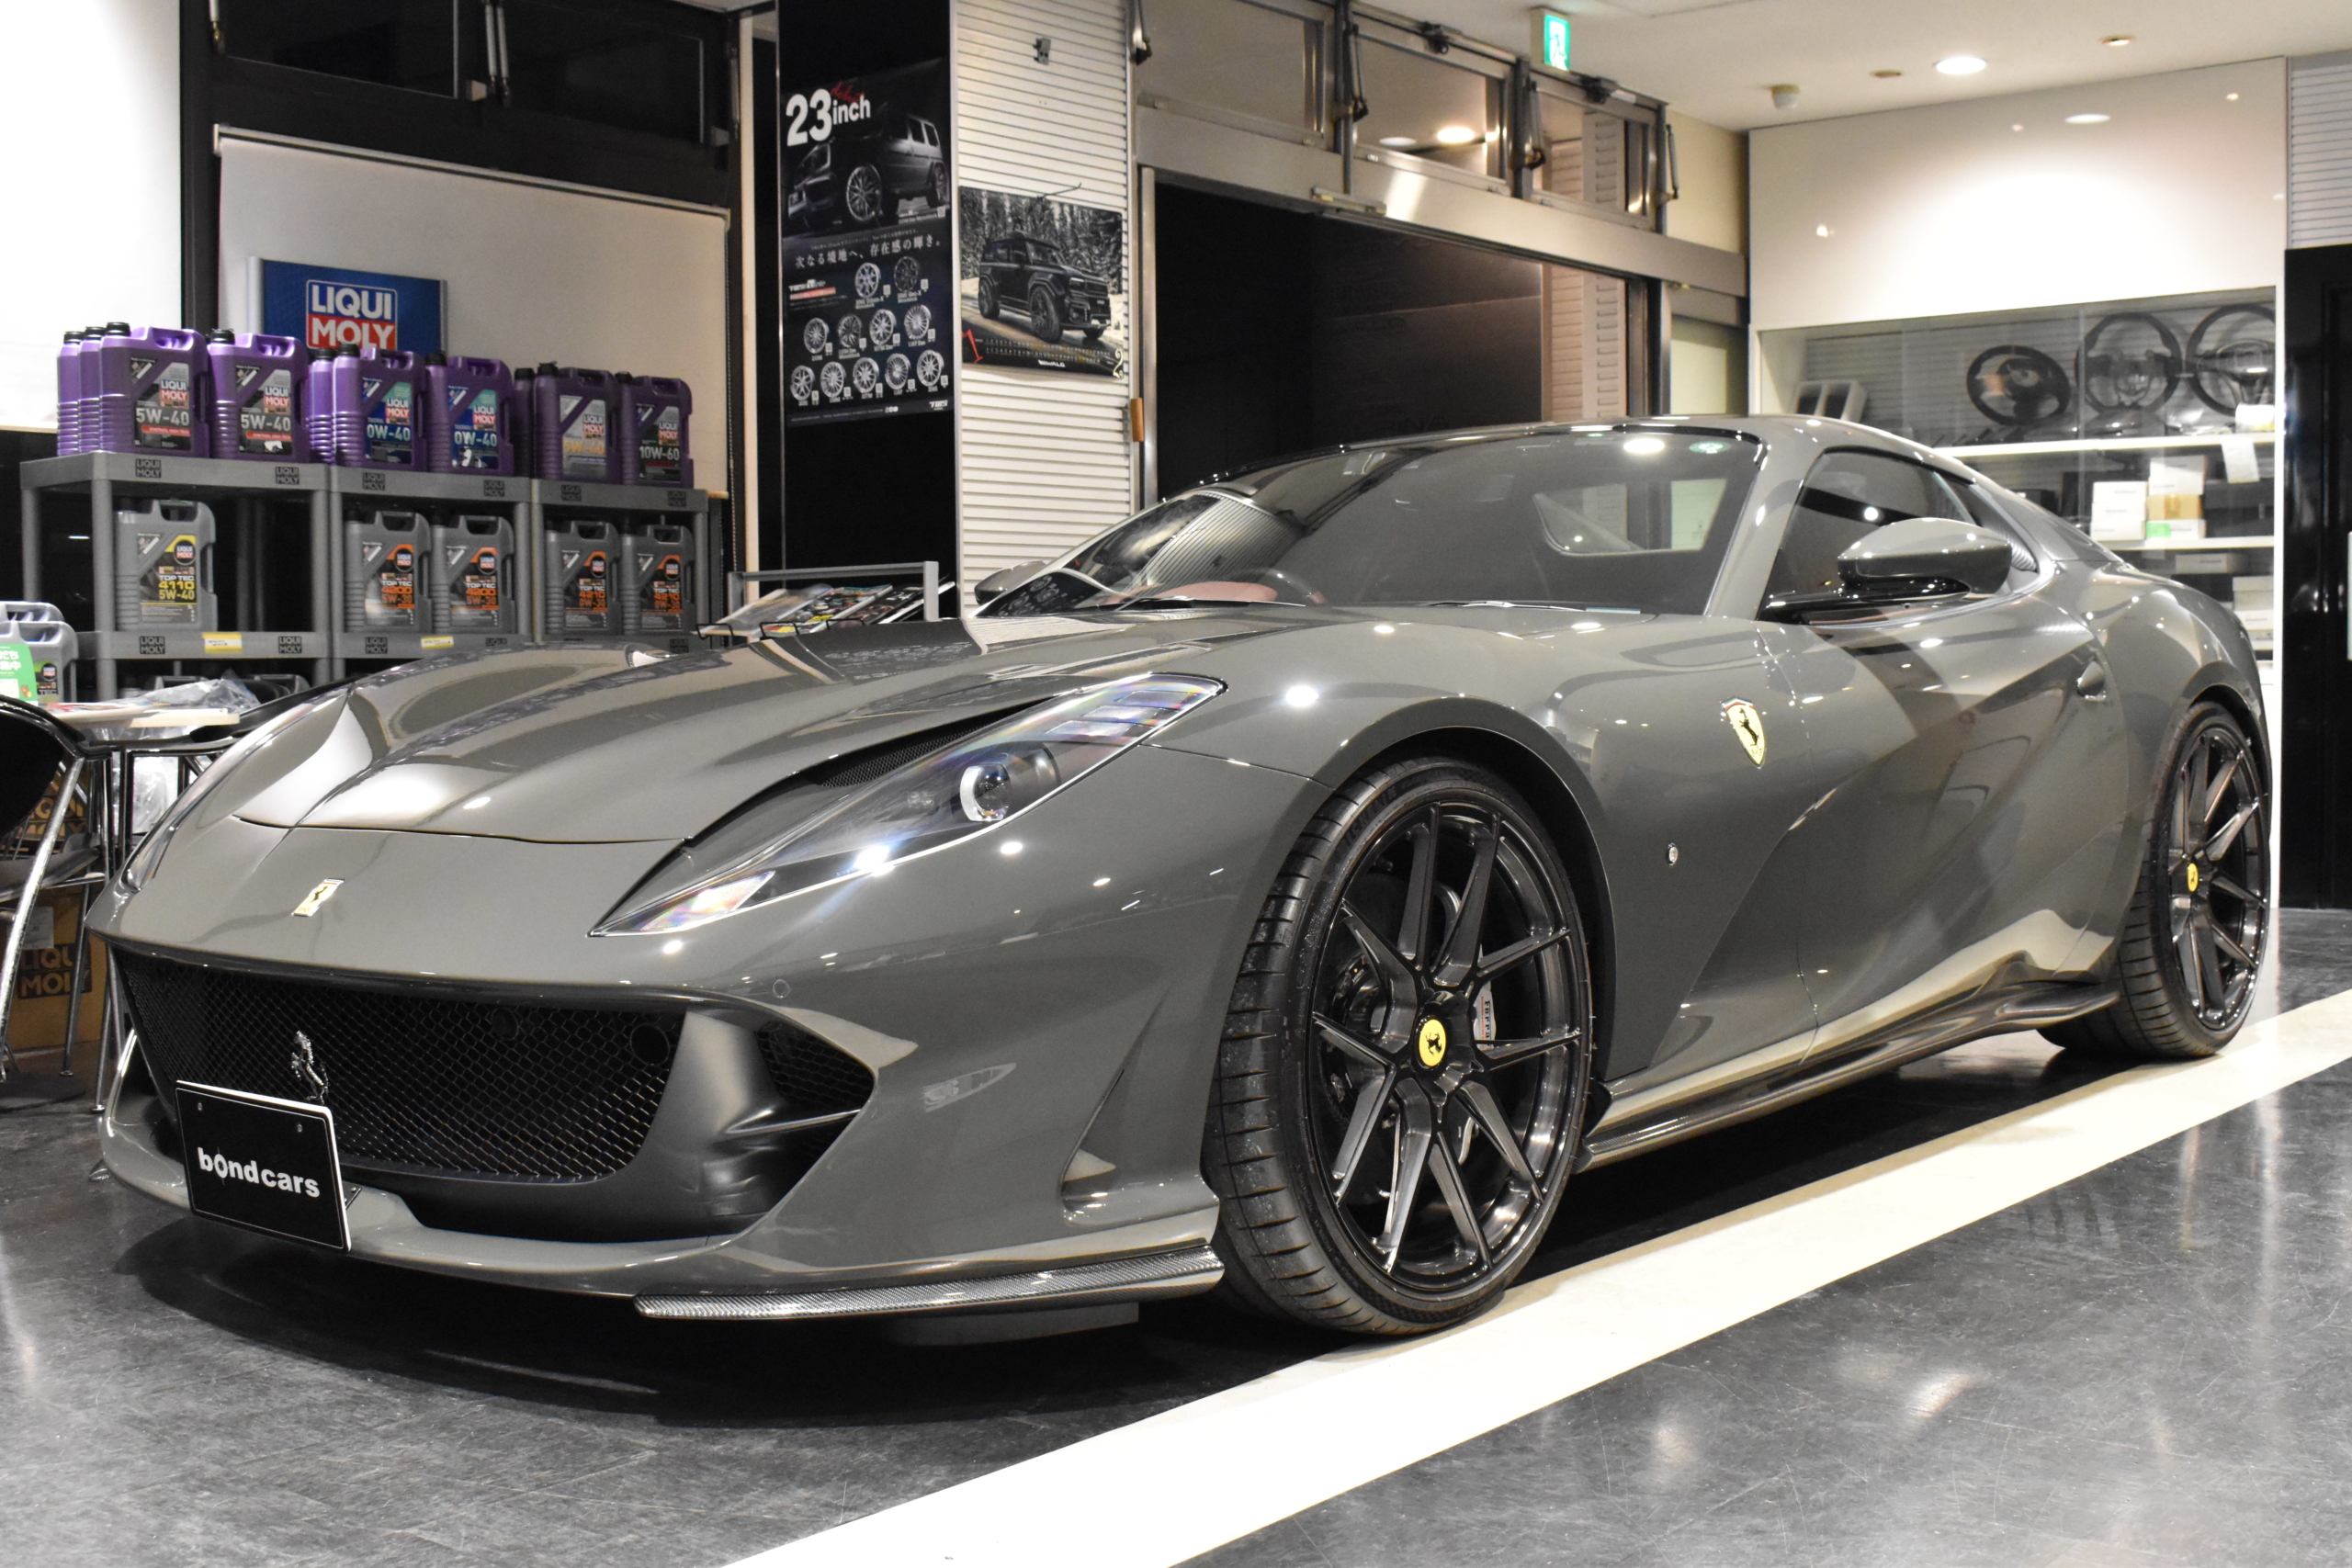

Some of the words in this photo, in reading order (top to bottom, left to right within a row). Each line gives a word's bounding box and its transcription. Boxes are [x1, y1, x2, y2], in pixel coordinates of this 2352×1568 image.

[786, 89, 831, 146] 23
[832, 96, 871, 125] inch
[312, 285, 392, 320] LIQUI
[312, 317, 395, 349] MOLY
[161, 379, 187, 390] LIQUI
[162, 389, 188, 400] MOLY
[265, 387, 288, 397] LIQUI
[266, 396, 289, 407] MOLY
[387, 399, 409, 408] LIQUI
[387, 408, 410, 418] MOLY
[474, 406, 494, 414] LIQUI
[136, 408, 189, 425] 5W-40
[474, 414, 496, 424] MOLY
[583, 415, 604, 424] LIQUI
[241, 414, 291, 432] 5W-40
[660, 422, 677, 430] LIQUI
[367, 423, 411, 441] 0W-40
[583, 424, 604, 434] MOLY
[454, 432, 497, 446] 0W-40
[660, 430, 678, 439] MOLY
[639, 446, 680, 460] 10W-60
[158, 581, 195, 590] 4110
[159, 590, 195, 600] 5W-40
[141, 637, 164, 645] LIQUI
[141, 646, 165, 654] MOLY
[279, 646, 302, 654] MOLY
